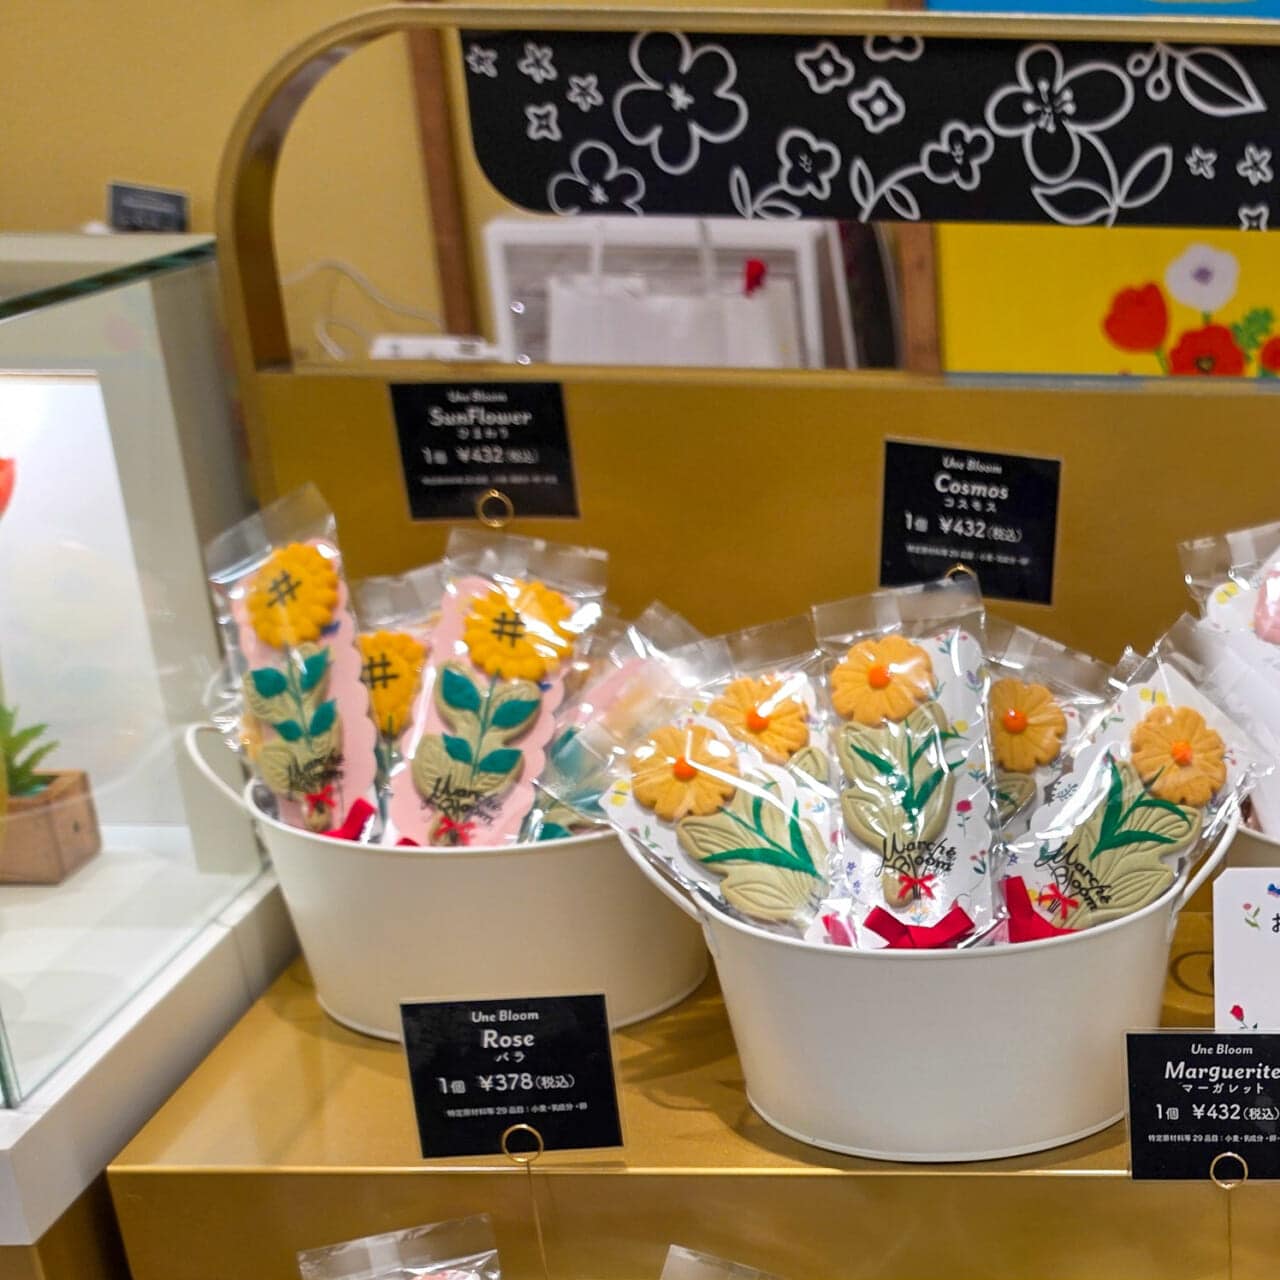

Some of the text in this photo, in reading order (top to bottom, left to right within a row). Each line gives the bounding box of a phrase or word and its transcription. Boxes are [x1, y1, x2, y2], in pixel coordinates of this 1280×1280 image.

[428, 405, 533, 426] SunFlower
[934, 473, 1009, 500] Cosmos
[944, 497, 997, 513] コスモス
[471, 1009, 540, 1024] Une Bloom
[482, 1028, 536, 1050] Rose
[1191, 1043, 1254, 1056] Une Bloom
[438, 1076, 467, 1095] 1個
[1181, 1082, 1266, 1095] マーガレット
[1155, 1104, 1181, 1121] 1個
